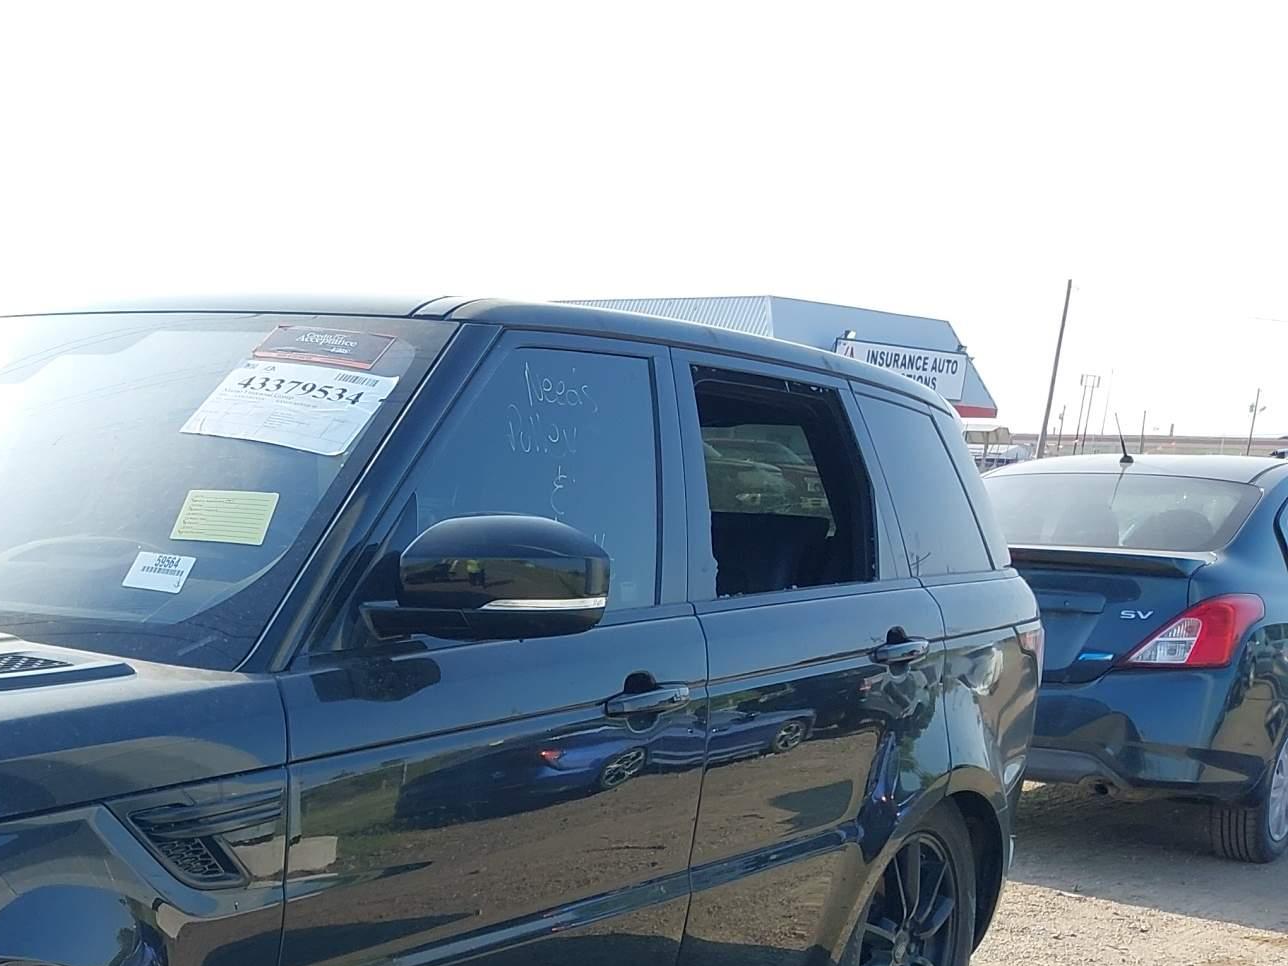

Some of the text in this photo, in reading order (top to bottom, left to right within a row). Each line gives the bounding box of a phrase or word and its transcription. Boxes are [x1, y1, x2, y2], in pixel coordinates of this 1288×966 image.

[866, 349, 929, 372] INSURANCE
[931, 357, 958, 375] AUTO
[237, 375, 365, 405] 43379534
[154, 554, 180, 569] 59564
[1120, 609, 1154, 620] SV
